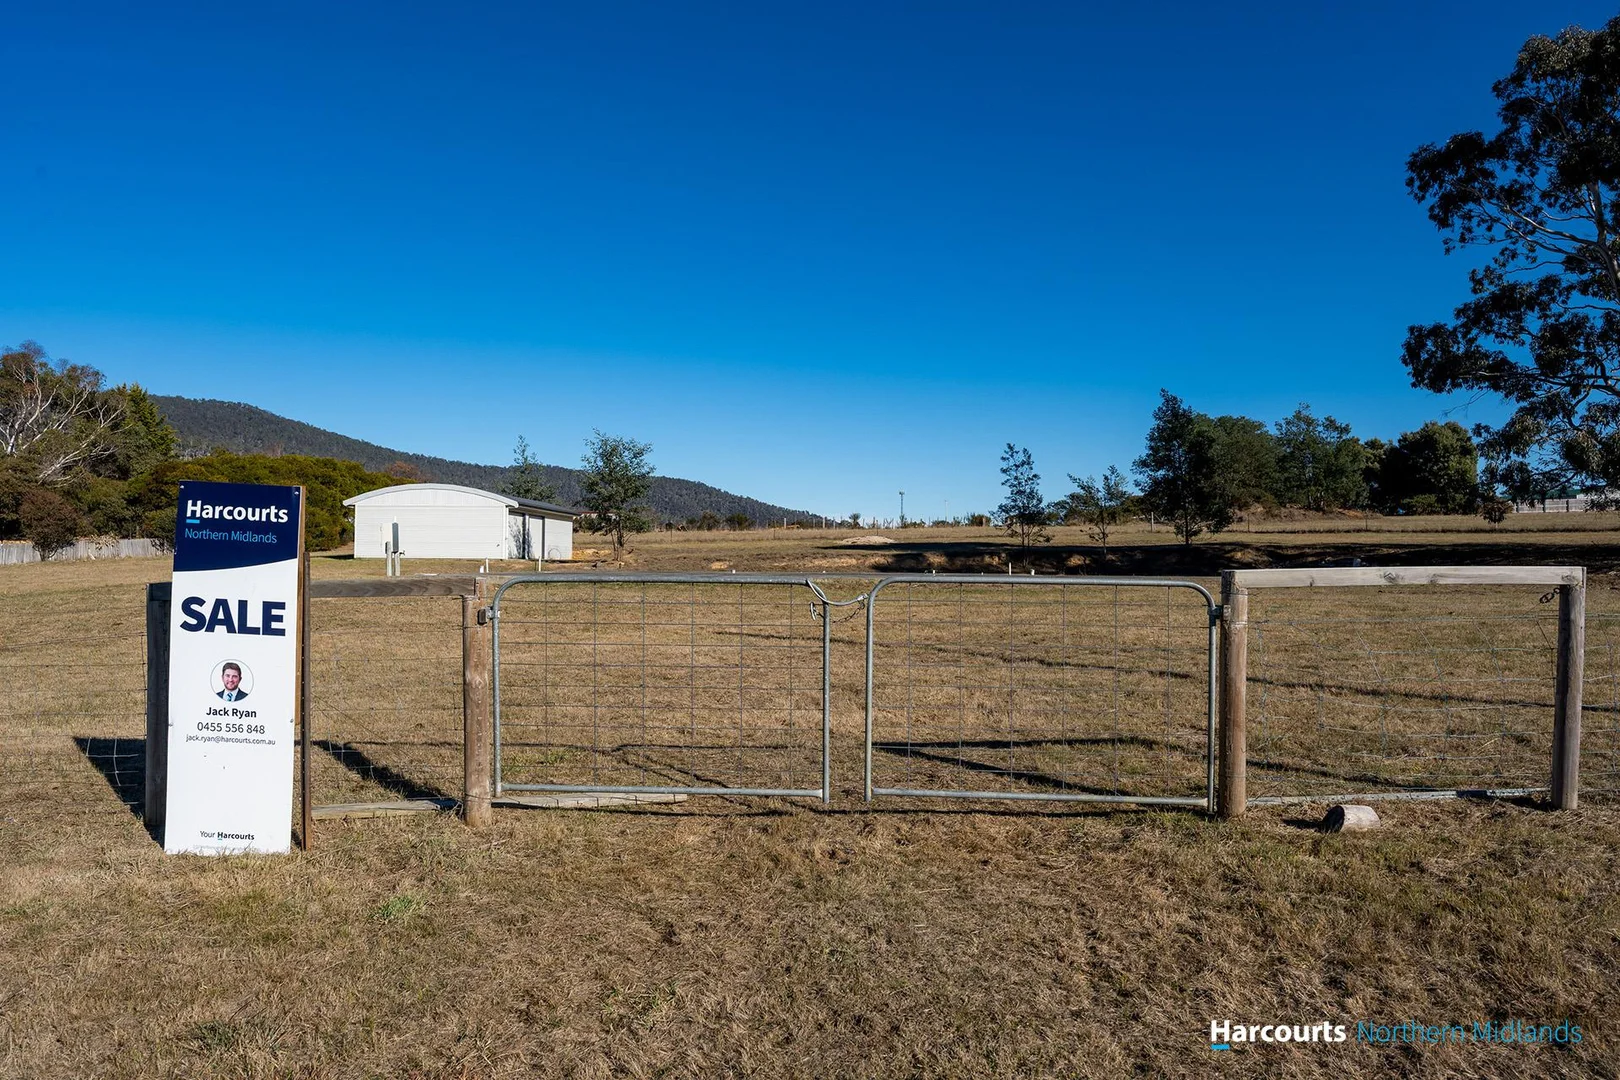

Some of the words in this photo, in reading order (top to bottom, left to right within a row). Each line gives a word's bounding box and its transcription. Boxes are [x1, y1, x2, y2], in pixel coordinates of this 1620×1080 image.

[186, 499, 289, 523] Harcourts
[184, 528, 229, 541] Northern
[231, 530, 278, 544] Midlands
[180, 596, 286, 637] SALE
[206, 707, 230, 717] Jack
[231, 708, 257, 720] Ryan
[197, 721, 223, 732] 0455
[225, 723, 244, 734] 556
[246, 724, 266, 735] 848
[186, 734, 276, 745] jack.ryan@harcourts.com.au
[200, 830, 216, 839] Your
[217, 831, 255, 841] Harcourts
